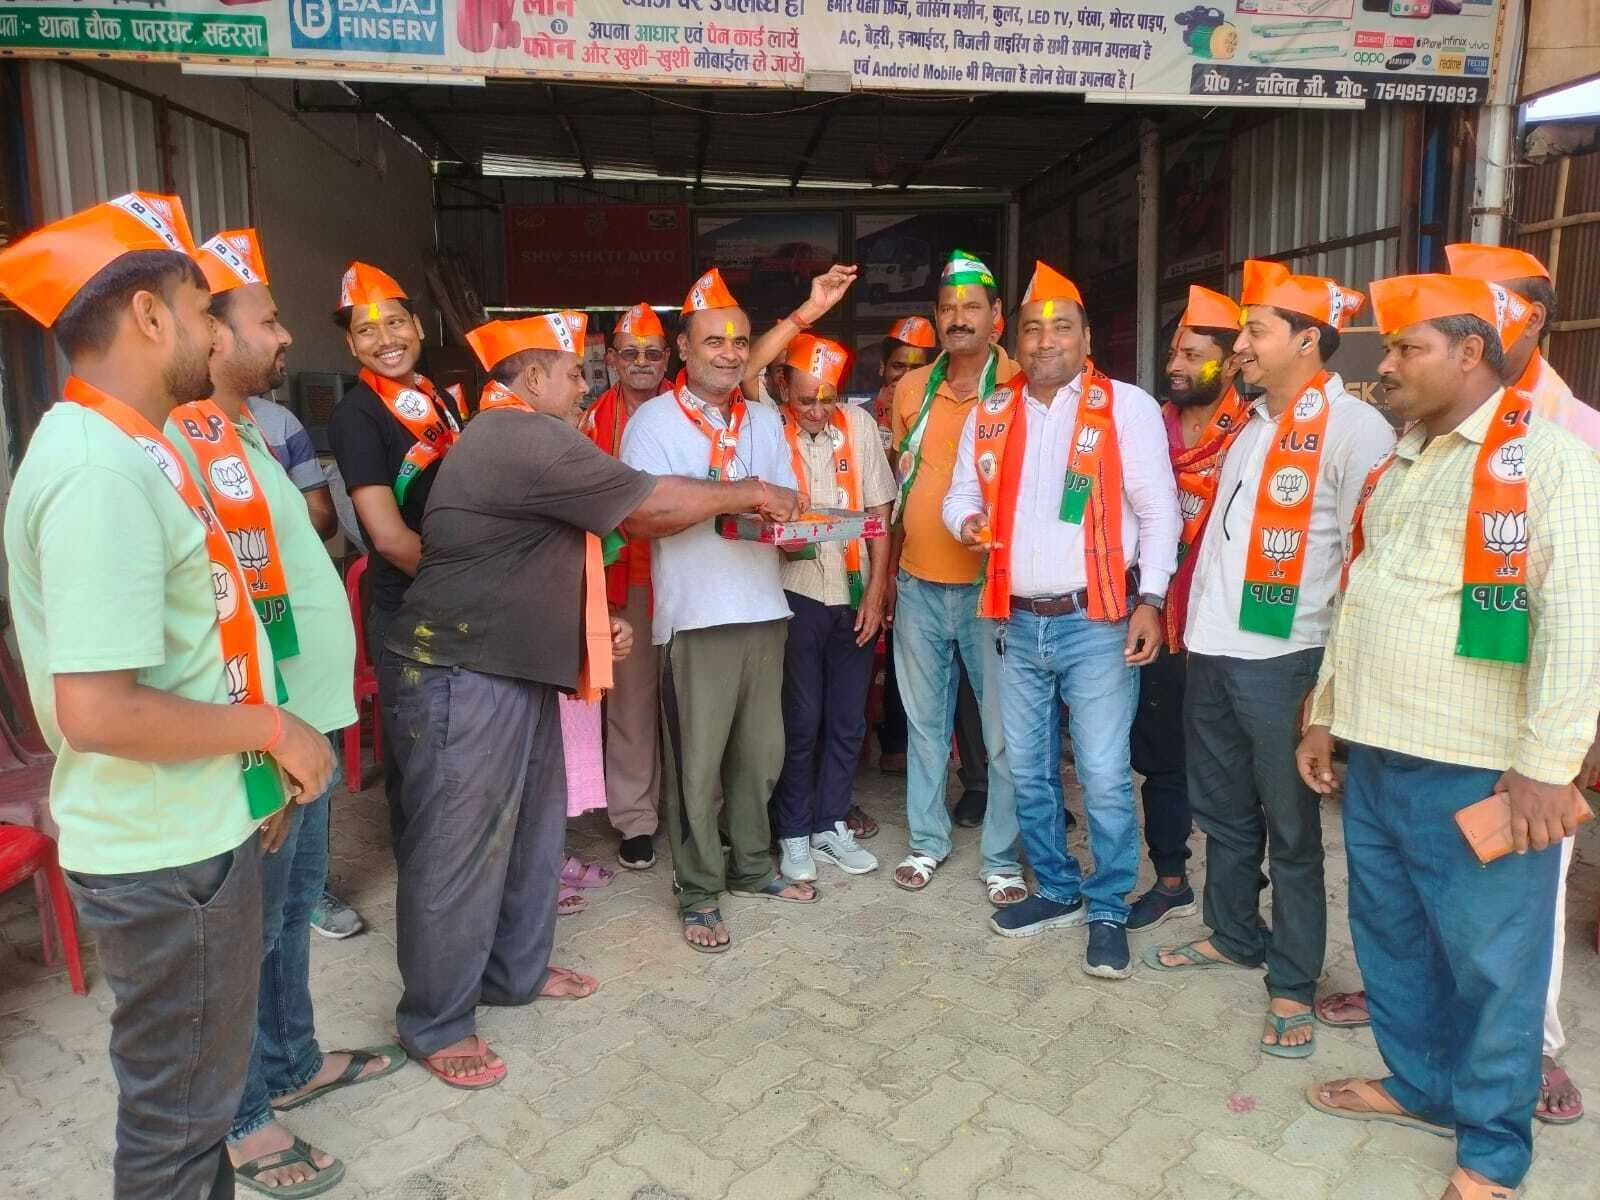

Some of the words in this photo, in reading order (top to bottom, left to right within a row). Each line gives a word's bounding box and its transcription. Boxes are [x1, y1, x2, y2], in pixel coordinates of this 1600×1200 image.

[338, 16, 438, 42] FINSERV
[1027, 9, 1050, 25] LED
[38, 15, 80, 39] थाना
[203, 22, 263, 47] सहरसा
[588, 21, 631, 41] अपना
[684, 21, 704, 44] एवं
[733, 24, 765, 47] कार्ड
[522, 32, 577, 60] फोन
[953, 29, 991, 51] बिजली
[1033, 34, 1045, 54] के
[1143, 40, 1153, 60] है
[752, 50, 767, 72] ले
[853, 55, 871, 75] एवं
[872, 61, 920, 78] Android
[923, 63, 963, 81] Mobile
[966, 61, 979, 81] भी
[1029, 64, 1054, 85] लोन
[1353, 51, 1385, 66] oppo
[1255, 73, 1299, 95] ललित
[1375, 82, 1477, 104] 7549579893
[521, 250, 563, 264] SHIV
[627, 250, 676, 264] AUTO
[553, 317, 570, 348] BJP
[978, 423, 1006, 441] BJP
[1065, 470, 1090, 492] JP
[259, 599, 287, 625] JP
